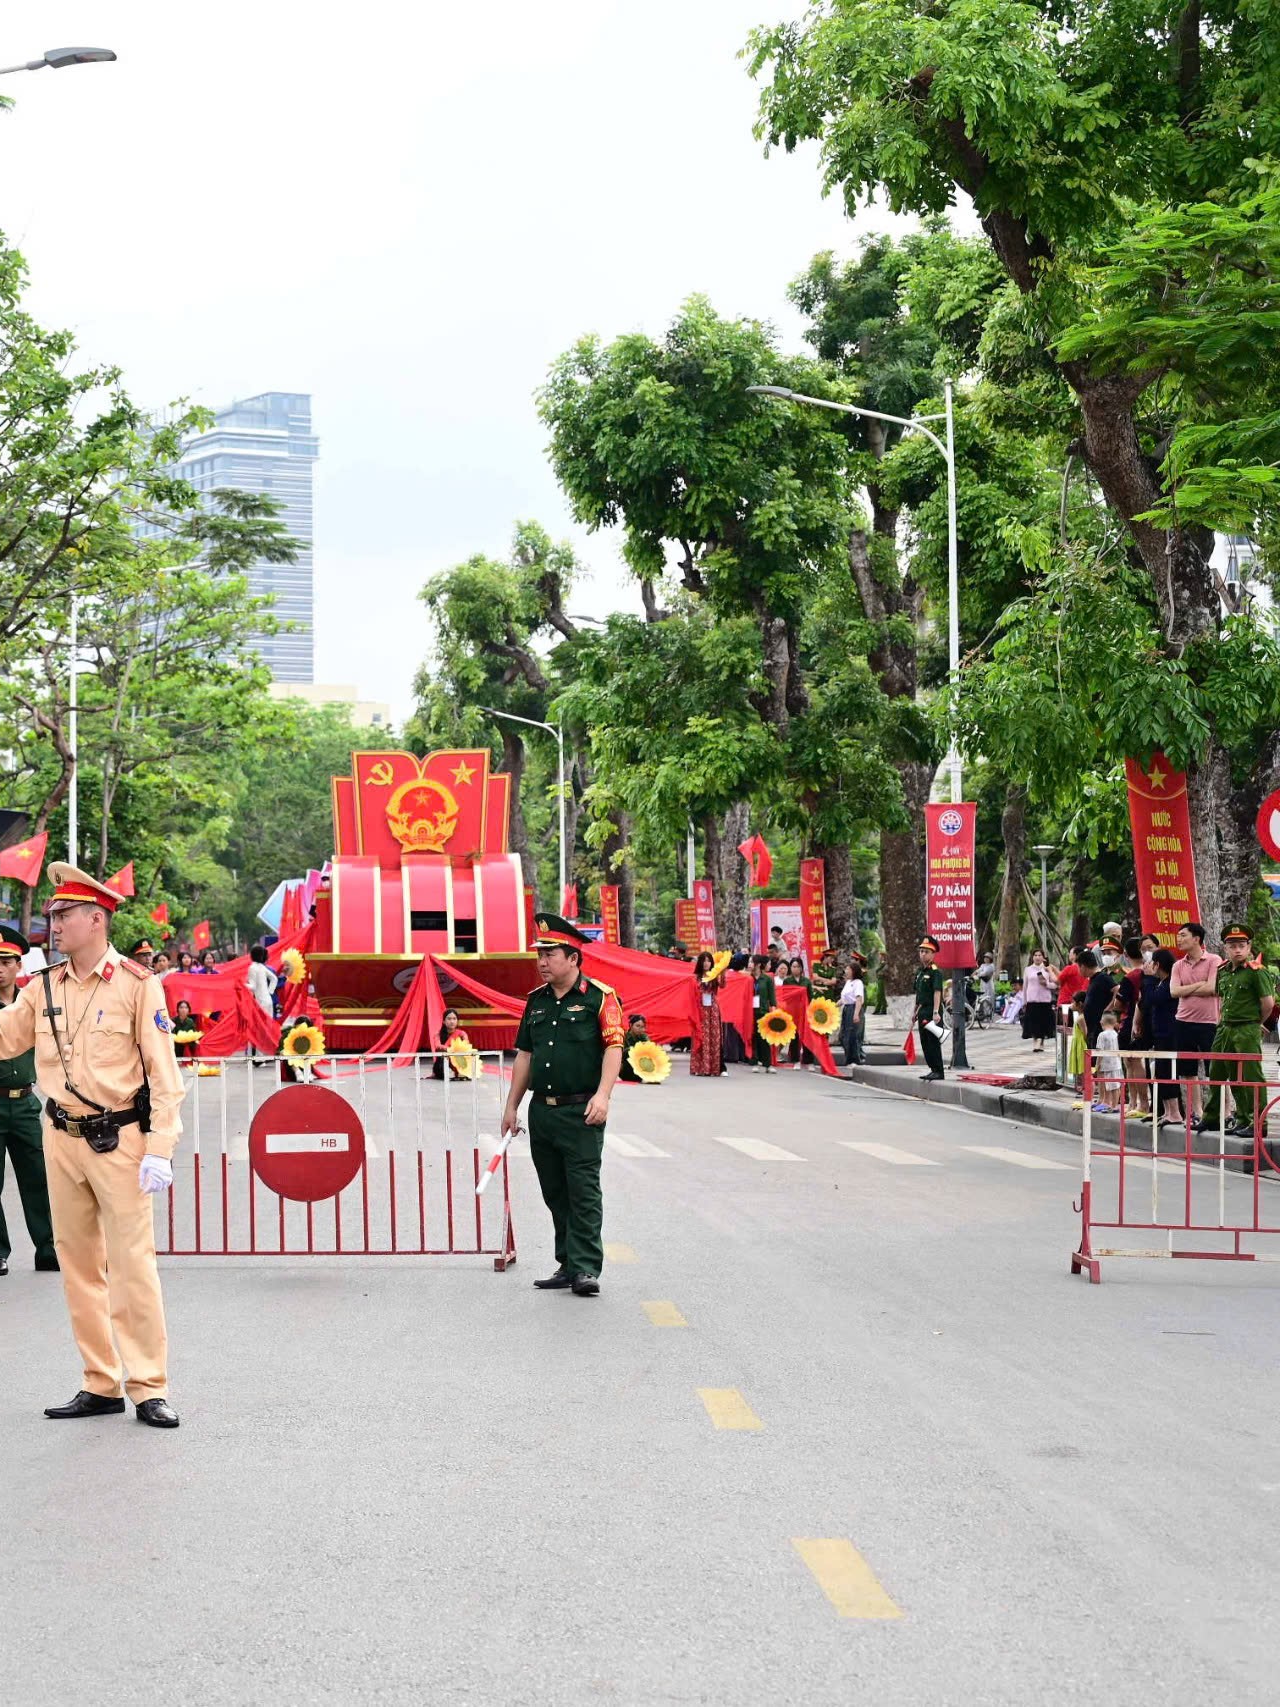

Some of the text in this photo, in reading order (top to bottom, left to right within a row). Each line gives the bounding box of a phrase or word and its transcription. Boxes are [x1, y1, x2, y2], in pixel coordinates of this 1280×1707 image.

[1151, 810, 1171, 827] NƯỚC
[1146, 834, 1168, 854] CỘNG
[1155, 858, 1179, 879] XÃ HỘI
[930, 882, 971, 896] 70 NĂM
[1151, 880, 1189, 901] CHỦ NGHĨA
[954, 900, 966, 908] TIN
[946, 910, 957, 919] VÀ
[1156, 907, 1190, 926] VIỆT NAM
[931, 921, 972, 931] KHÁT VỌNG
[954, 932, 972, 941] MÌNH
[321, 1138, 337, 1147] HB
